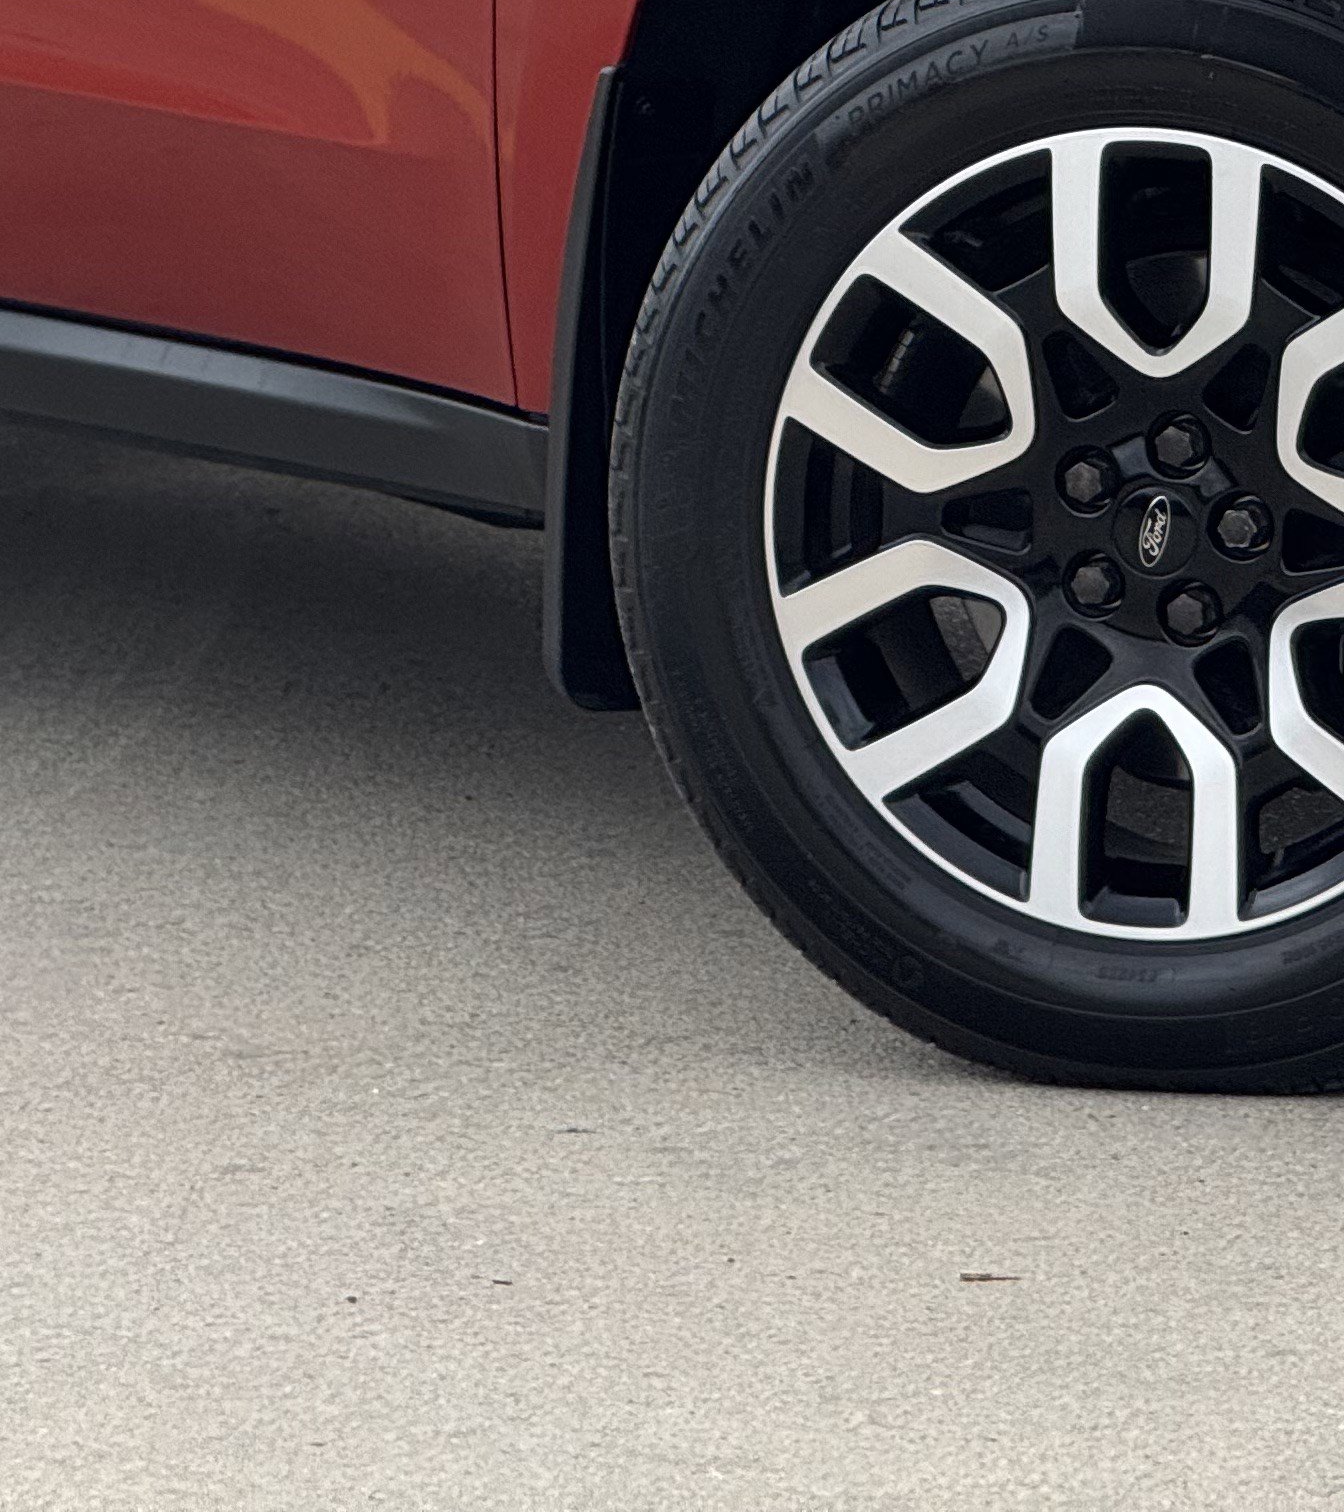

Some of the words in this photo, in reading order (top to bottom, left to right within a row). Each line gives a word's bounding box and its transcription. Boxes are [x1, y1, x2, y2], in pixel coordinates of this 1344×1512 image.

[846, 38, 989, 126] PRIMACY
[1006, 23, 1050, 49] A/S
[1141, 507, 1168, 557] Ford
